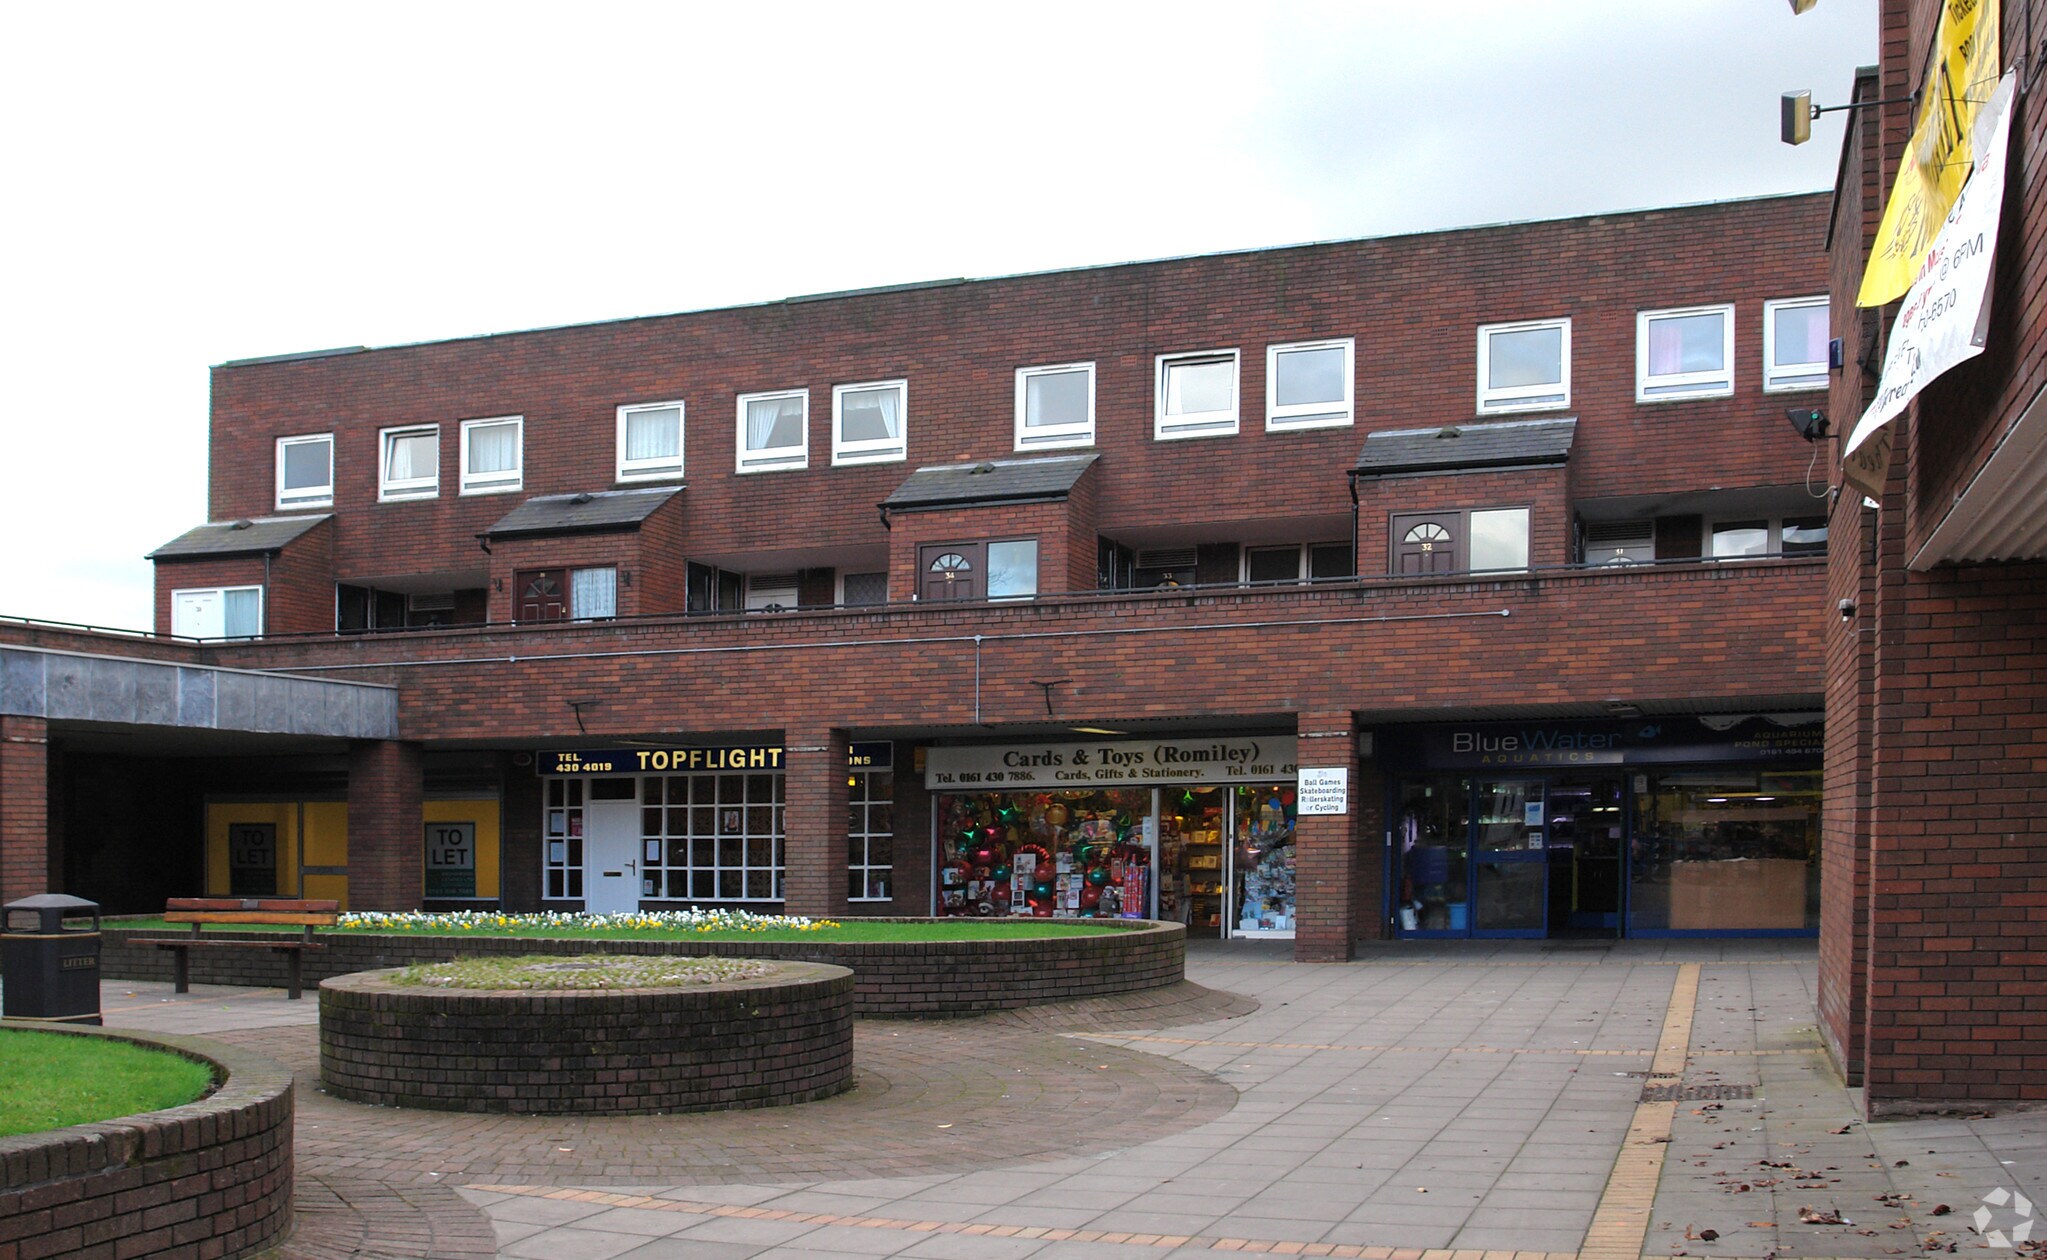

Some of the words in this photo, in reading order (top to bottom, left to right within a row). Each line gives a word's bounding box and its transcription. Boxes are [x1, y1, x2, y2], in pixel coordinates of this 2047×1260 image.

[1421, 543, 1432, 551] 32
[1734, 740, 1770, 749] POND
[1775, 738, 1824, 748] SPECIA
[558, 753, 582, 762] TEL.
[636, 748, 783, 770] TOPFLIGHT
[1003, 750, 1063, 767] Cards
[1072, 749, 1089, 765] &
[1098, 748, 1144, 767] Toys
[1153, 741, 1260, 765] (Romiley)
[1481, 752, 1594, 763] AQUATICS
[556, 763, 579, 772] 430
[582, 762, 612, 771] 4019
[935, 773, 955, 783] Tel.
[959, 772, 982, 783] 0161
[985, 771, 1004, 781] 430
[1008, 771, 1036, 781] 7886.
[1054, 770, 1091, 781] Cards,
[1095, 769, 1123, 779] Gifts
[1128, 768, 1138, 778] &
[1142, 766, 1205, 779] Stationery.
[1225, 765, 1247, 776] Tel.
[1251, 764, 1274, 775] 0161
[1300, 787, 1346, 795] Skateboarding
[1314, 803, 1339, 812] Cycling
[241, 830, 265, 846] TO
[436, 829, 463, 846] TO
[236, 848, 270, 865] LET
[432, 848, 468, 865] LET
[63, 957, 96, 969] LITTER
